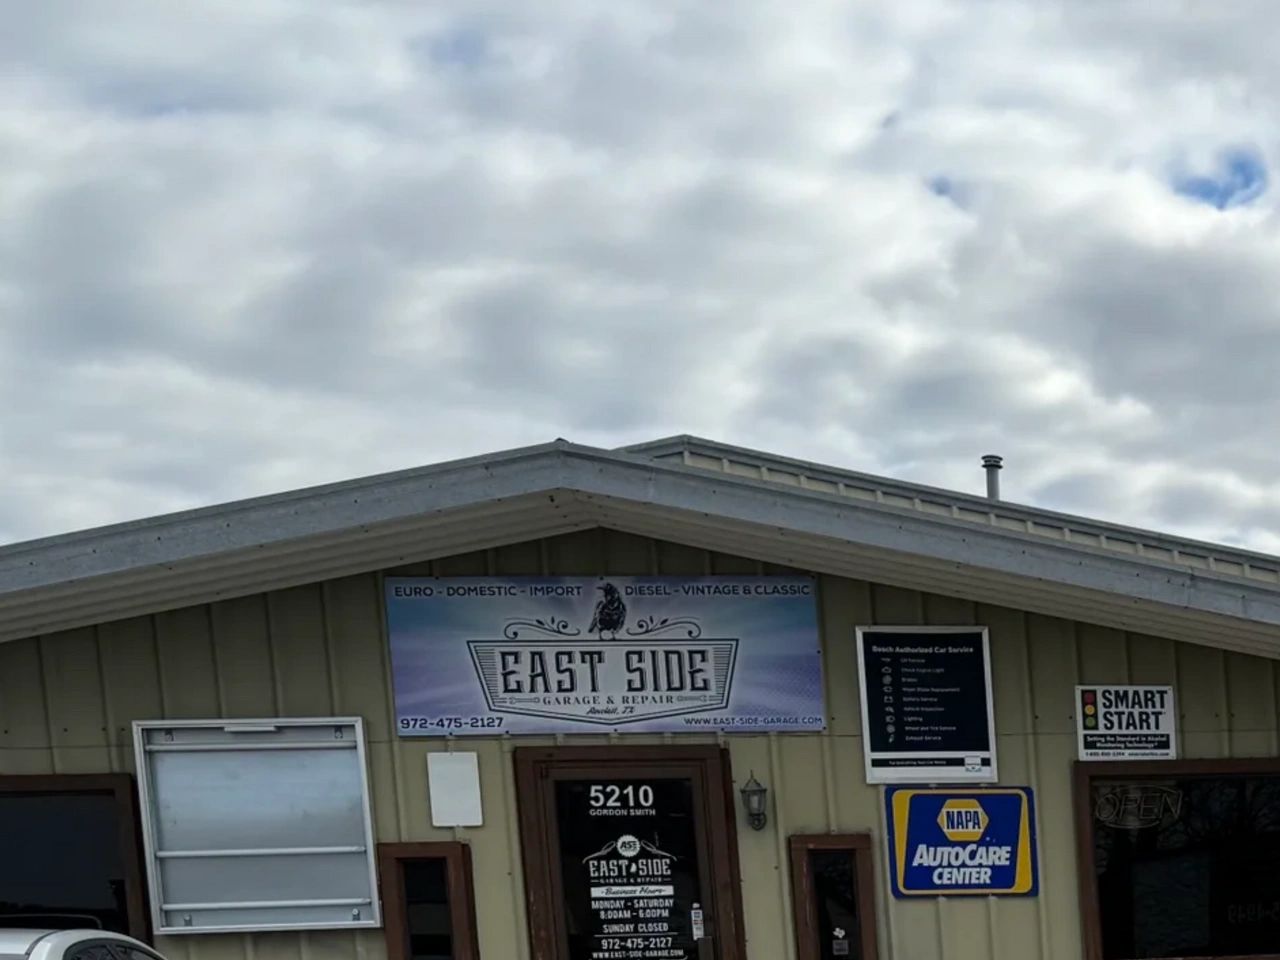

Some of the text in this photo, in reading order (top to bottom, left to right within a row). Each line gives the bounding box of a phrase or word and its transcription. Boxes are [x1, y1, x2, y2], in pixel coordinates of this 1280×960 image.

[395, 586, 433, 597] EURO
[447, 586, 517, 596] DOMESTIC
[530, 585, 583, 596] IMPORT
[625, 585, 671, 596] DIESEL
[681, 585, 740, 596] VINTAGE
[742, 585, 752, 595] &
[754, 584, 810, 595] CLASSIC
[500, 650, 711, 693] EAST SIDE
[542, 695, 674, 705] GARAGE & REPAIR
[1102, 689, 1167, 709] SMART
[401, 717, 504, 729] 972-475-2127
[1103, 711, 1162, 730] START
[590, 785, 654, 807] 5210
[589, 808, 656, 816] GORDON SMITH
[1096, 789, 1183, 822] OPEN
[945, 810, 981, 830] NAPA
[589, 858, 671, 877] EAST SIDE
[932, 868, 992, 884] CENTER
[591, 900, 625, 909] MONDAY
[633, 899, 674, 908] SATURDAY
[603, 922, 669, 933] SUNDAY CLOSED
[601, 937, 672, 949] 972-475-2127
